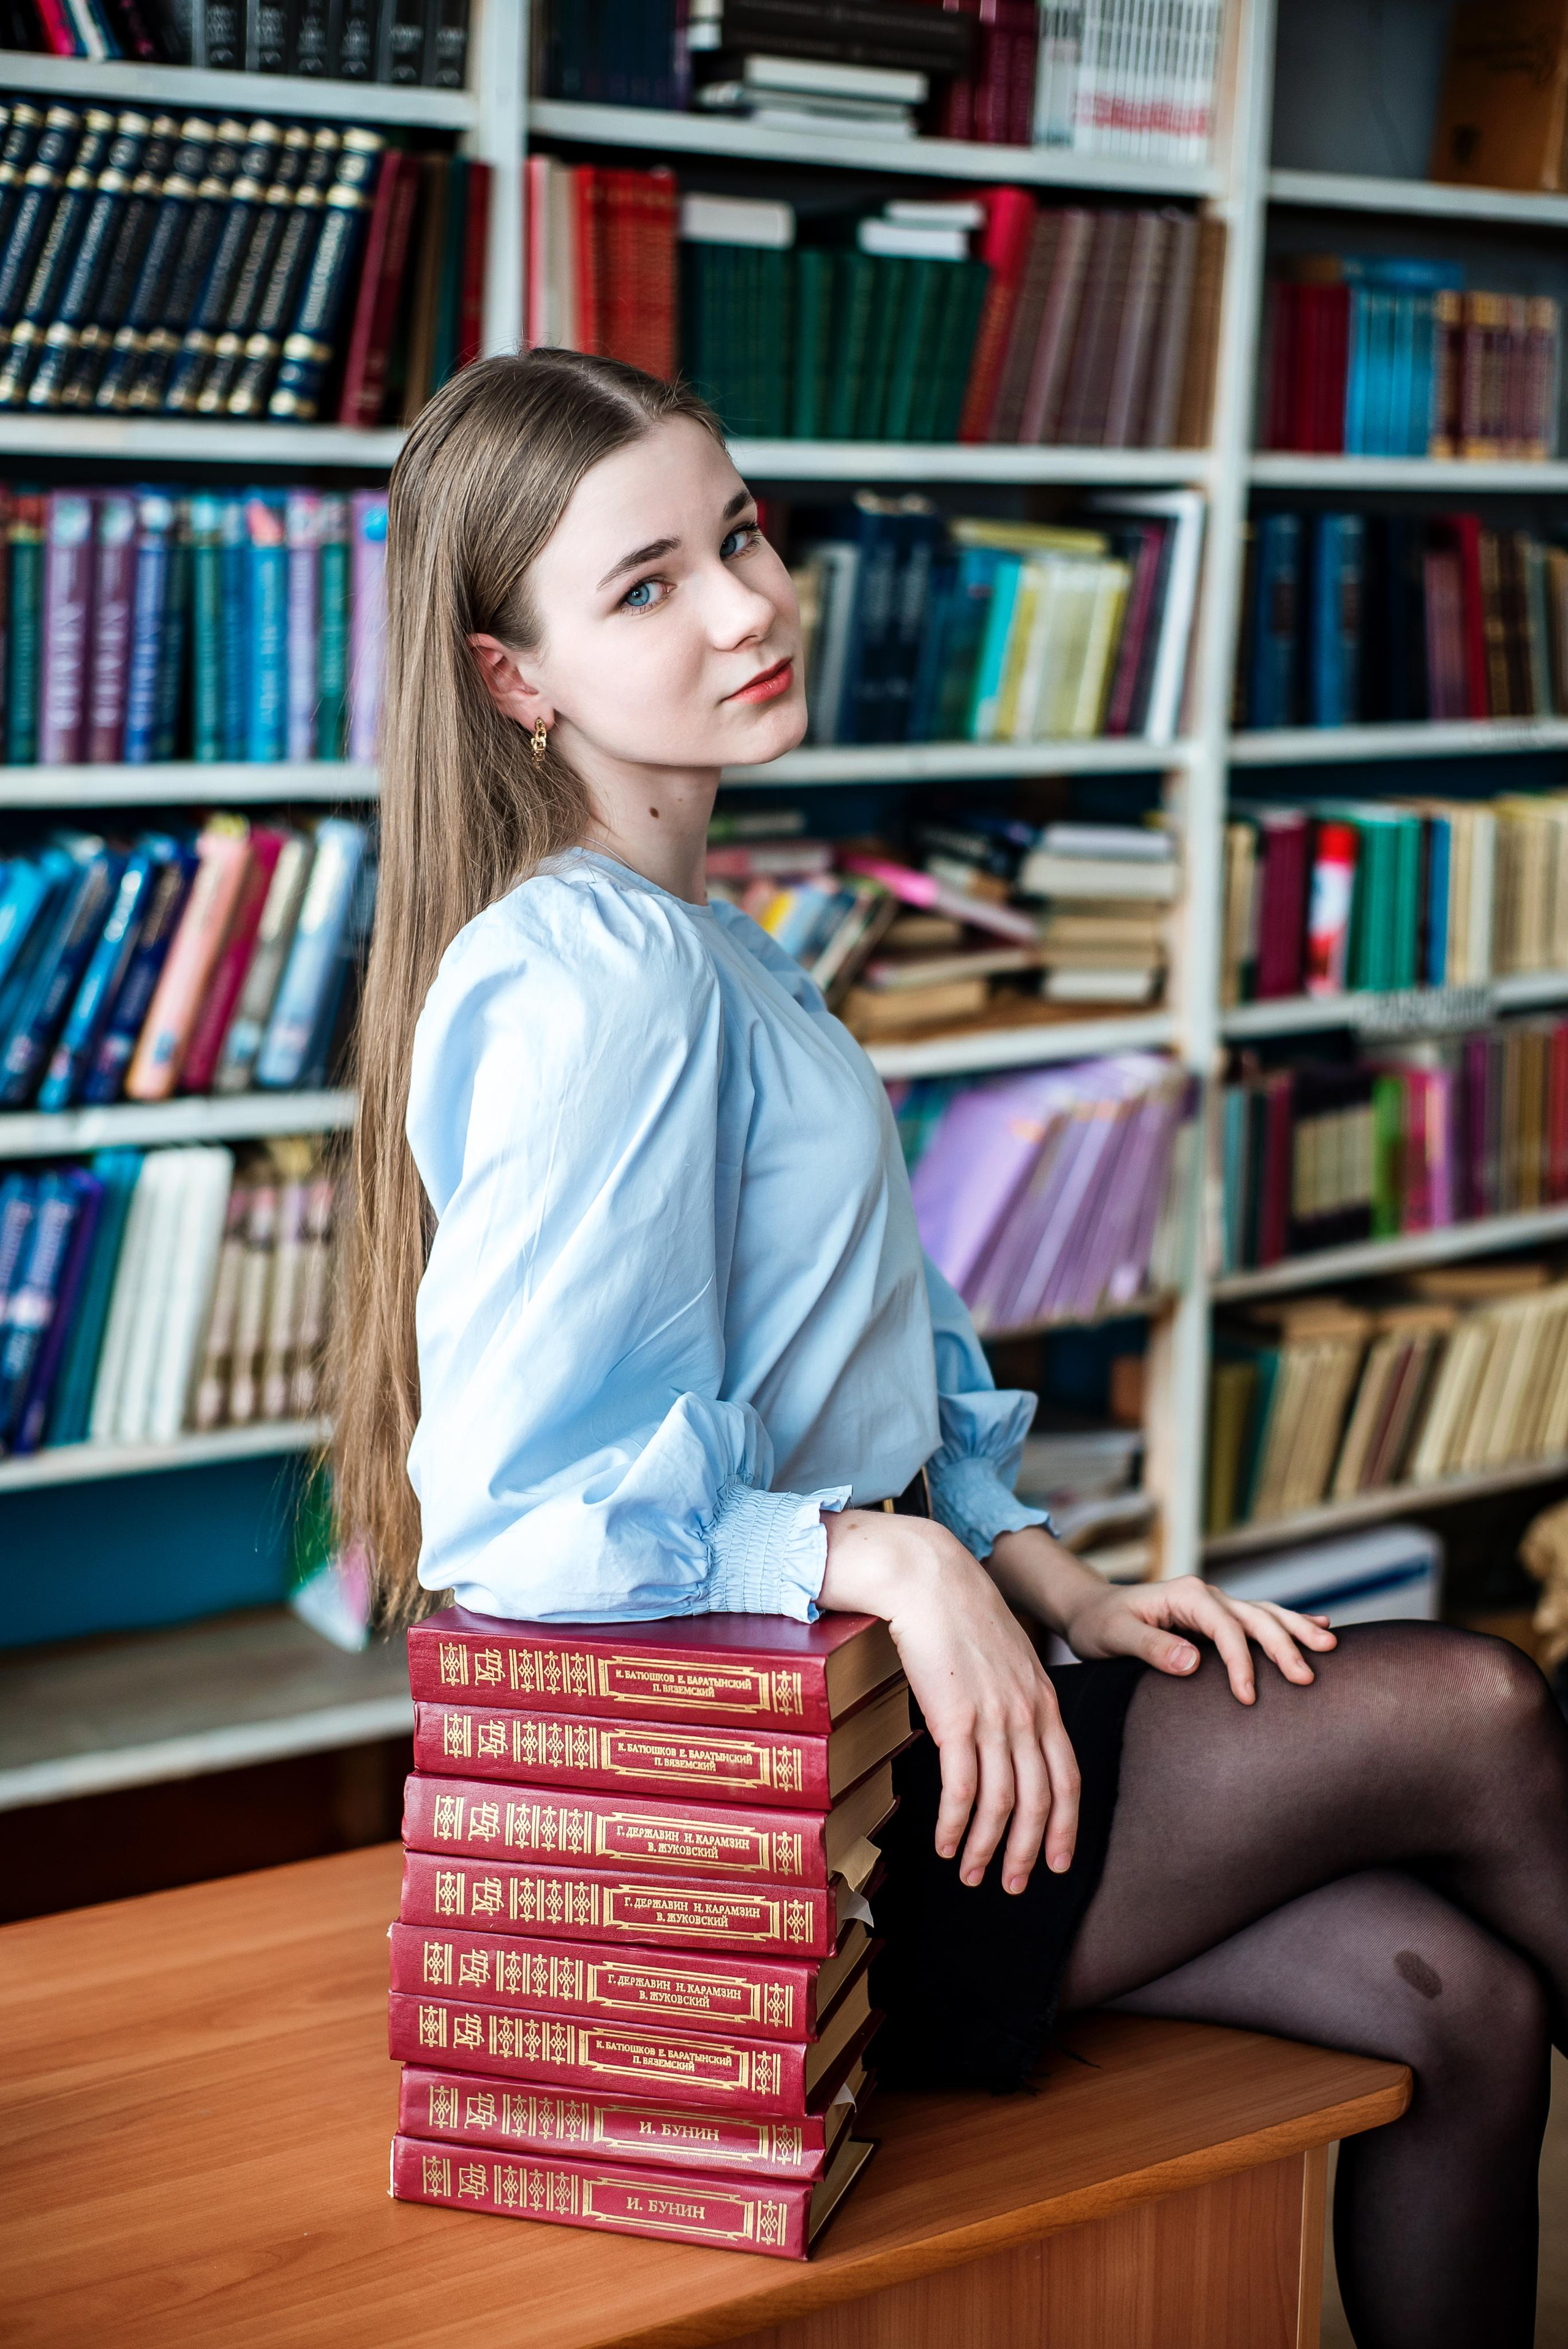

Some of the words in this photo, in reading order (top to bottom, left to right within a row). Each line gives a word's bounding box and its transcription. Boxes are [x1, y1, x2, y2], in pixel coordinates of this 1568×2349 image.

[639, 2121, 656, 2135] И.
[662, 2124, 719, 2141] БУНИН
[627, 2196, 643, 2211] И.
[648, 2200, 705, 2219] БУНИН
